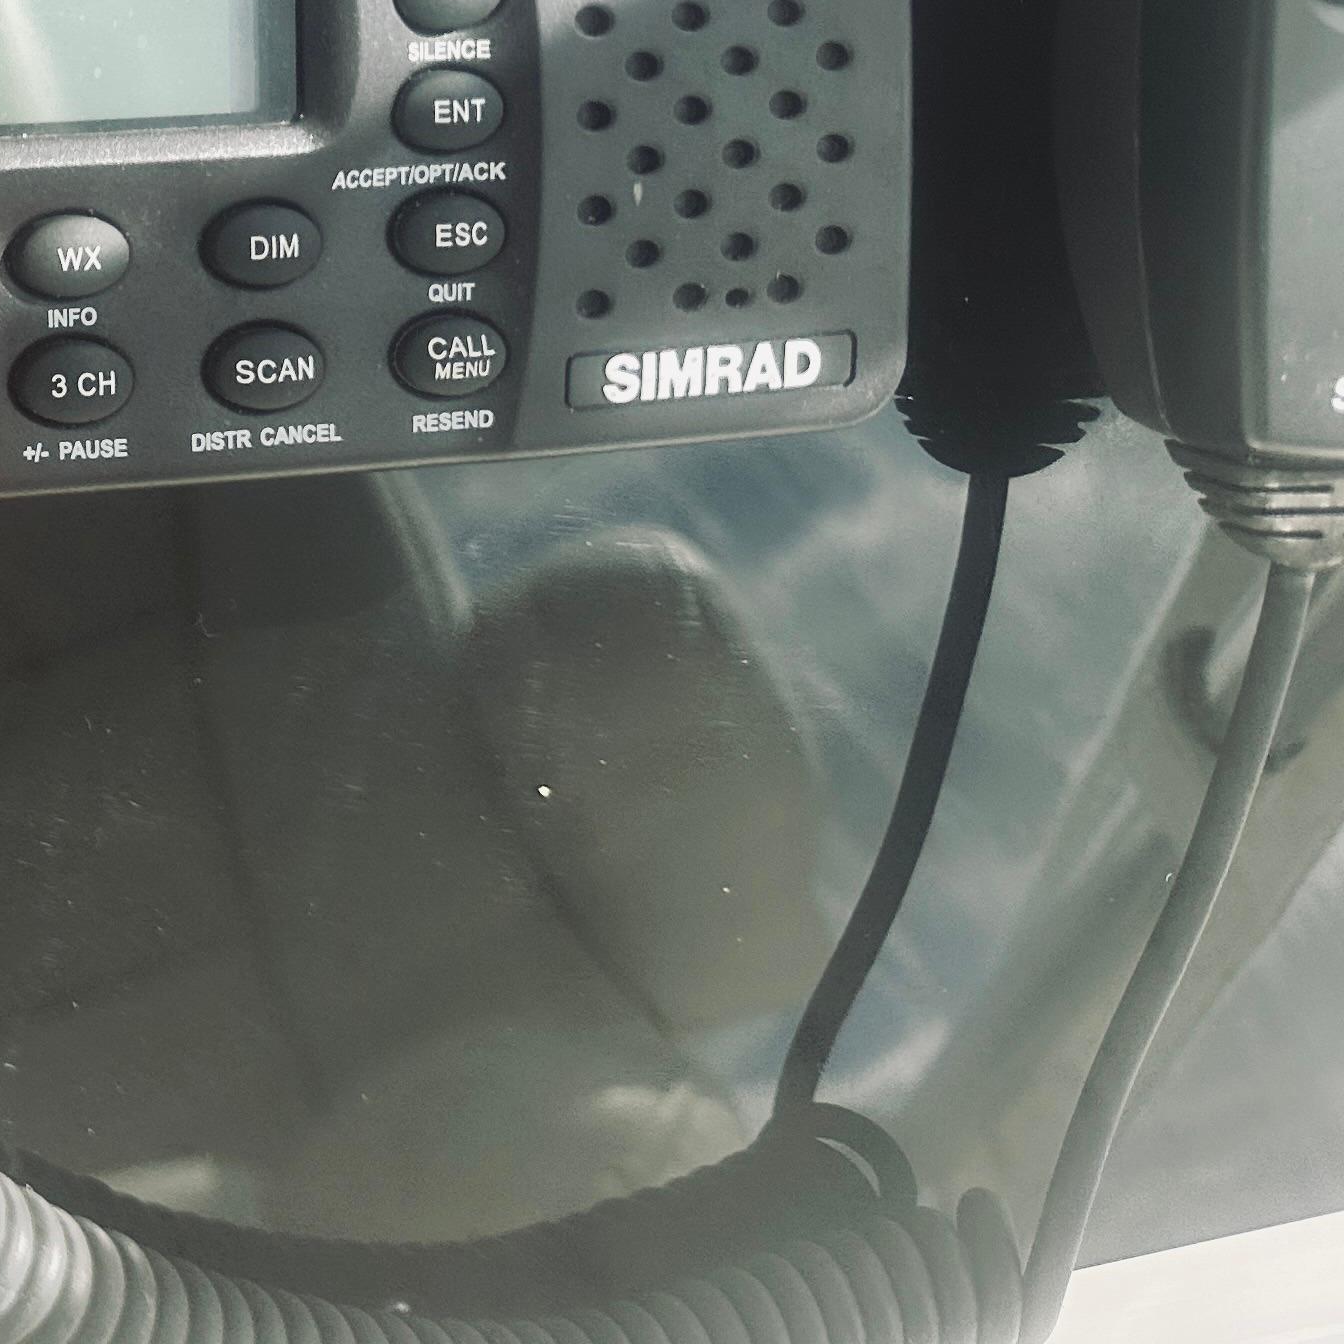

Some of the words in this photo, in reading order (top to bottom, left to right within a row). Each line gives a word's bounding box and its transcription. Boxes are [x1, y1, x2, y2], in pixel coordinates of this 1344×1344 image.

[408, 39, 491, 62] SILENCE
[433, 98, 486, 124] ENT
[331, 161, 507, 190] ACCEPT/OPT/ACK
[250, 234, 300, 262] DIM
[435, 221, 488, 249] ESC
[57, 245, 103, 273] WX
[428, 282, 476, 304] QUIT
[47, 307, 98, 330] INFO
[428, 335, 496, 360] CALL
[235, 356, 314, 385] SCAN
[434, 359, 490, 381] MENU
[602, 338, 822, 405] SIMRAD
[51, 374, 67, 398] 3
[77, 371, 116, 397] CH
[412, 409, 495, 433] RESEND
[58, 438, 129, 461] PAUSE
[191, 430, 252, 453] DISTR
[260, 423, 343, 447] CANCEL
